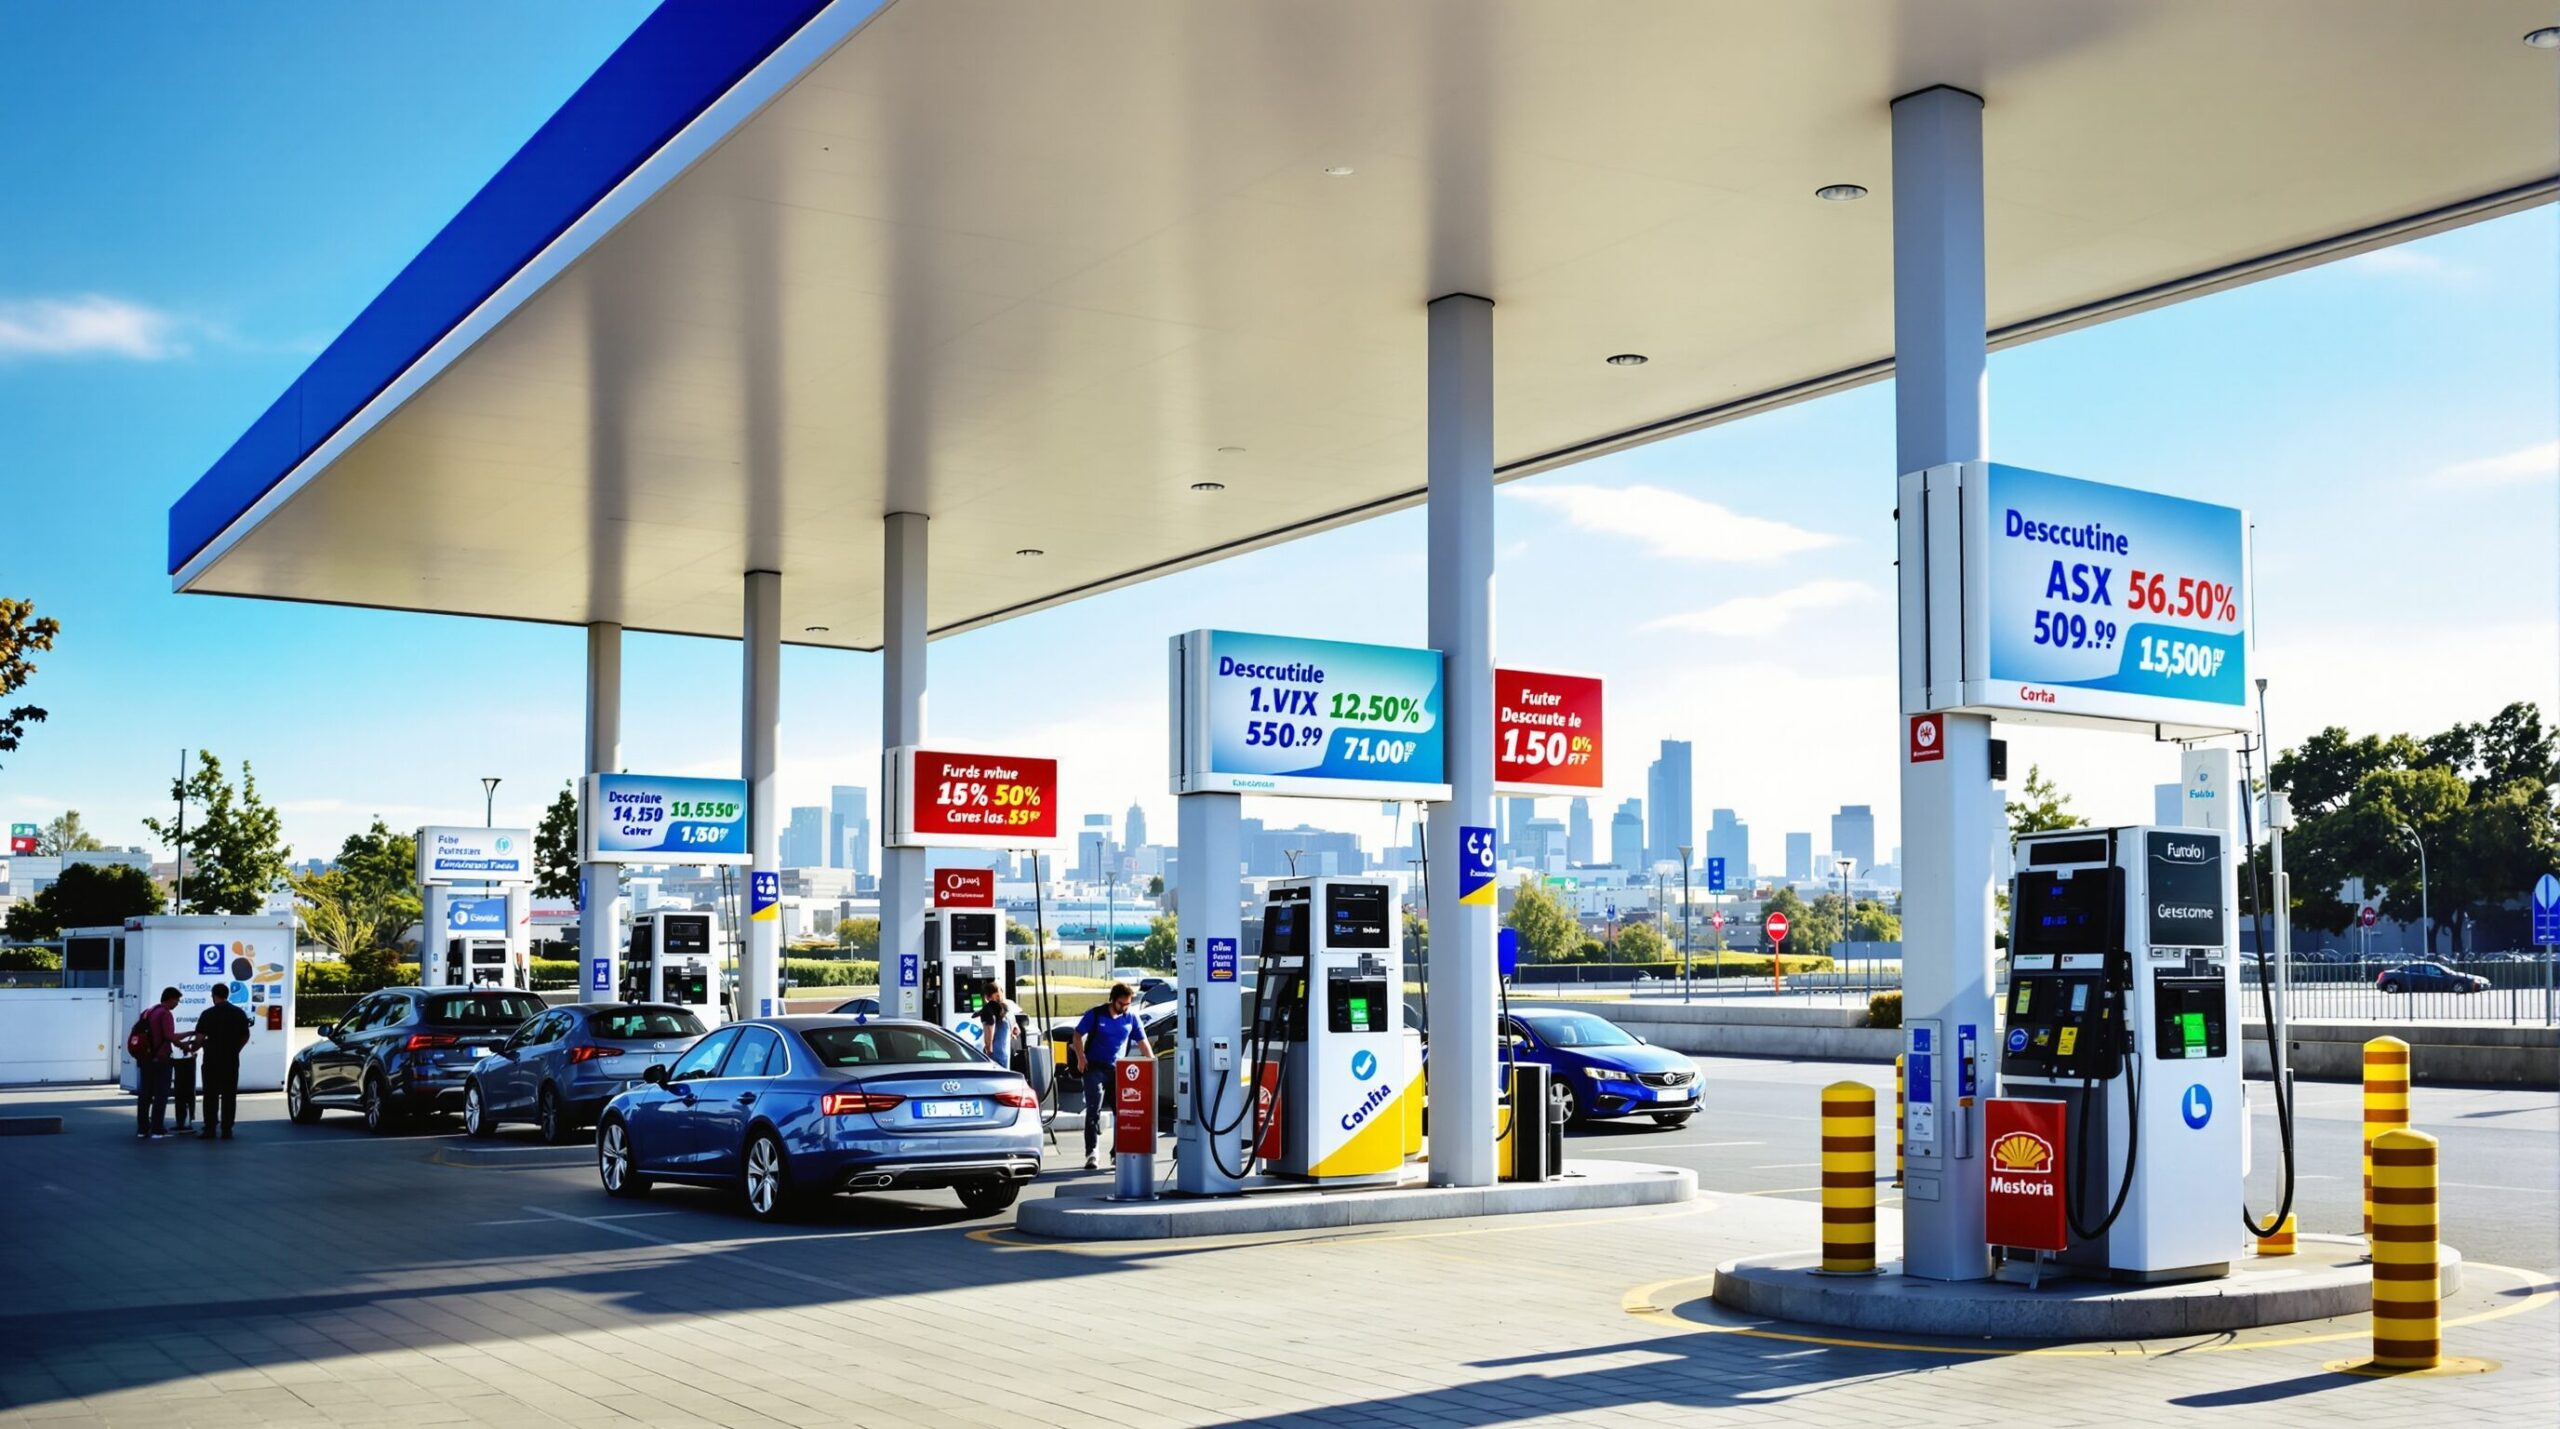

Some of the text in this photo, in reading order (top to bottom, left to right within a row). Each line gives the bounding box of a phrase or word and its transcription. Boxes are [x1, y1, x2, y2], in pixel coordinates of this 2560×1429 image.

[2006, 508, 2129, 556] Desccutine
[2046, 560, 2236, 622] ASX 56.50%
[1330, 692, 1419, 723] 12,50%
[1246, 721, 1323, 748] 550.99
[1501, 728, 1567, 766] 1.50
[992, 784, 1041, 806] 50%
